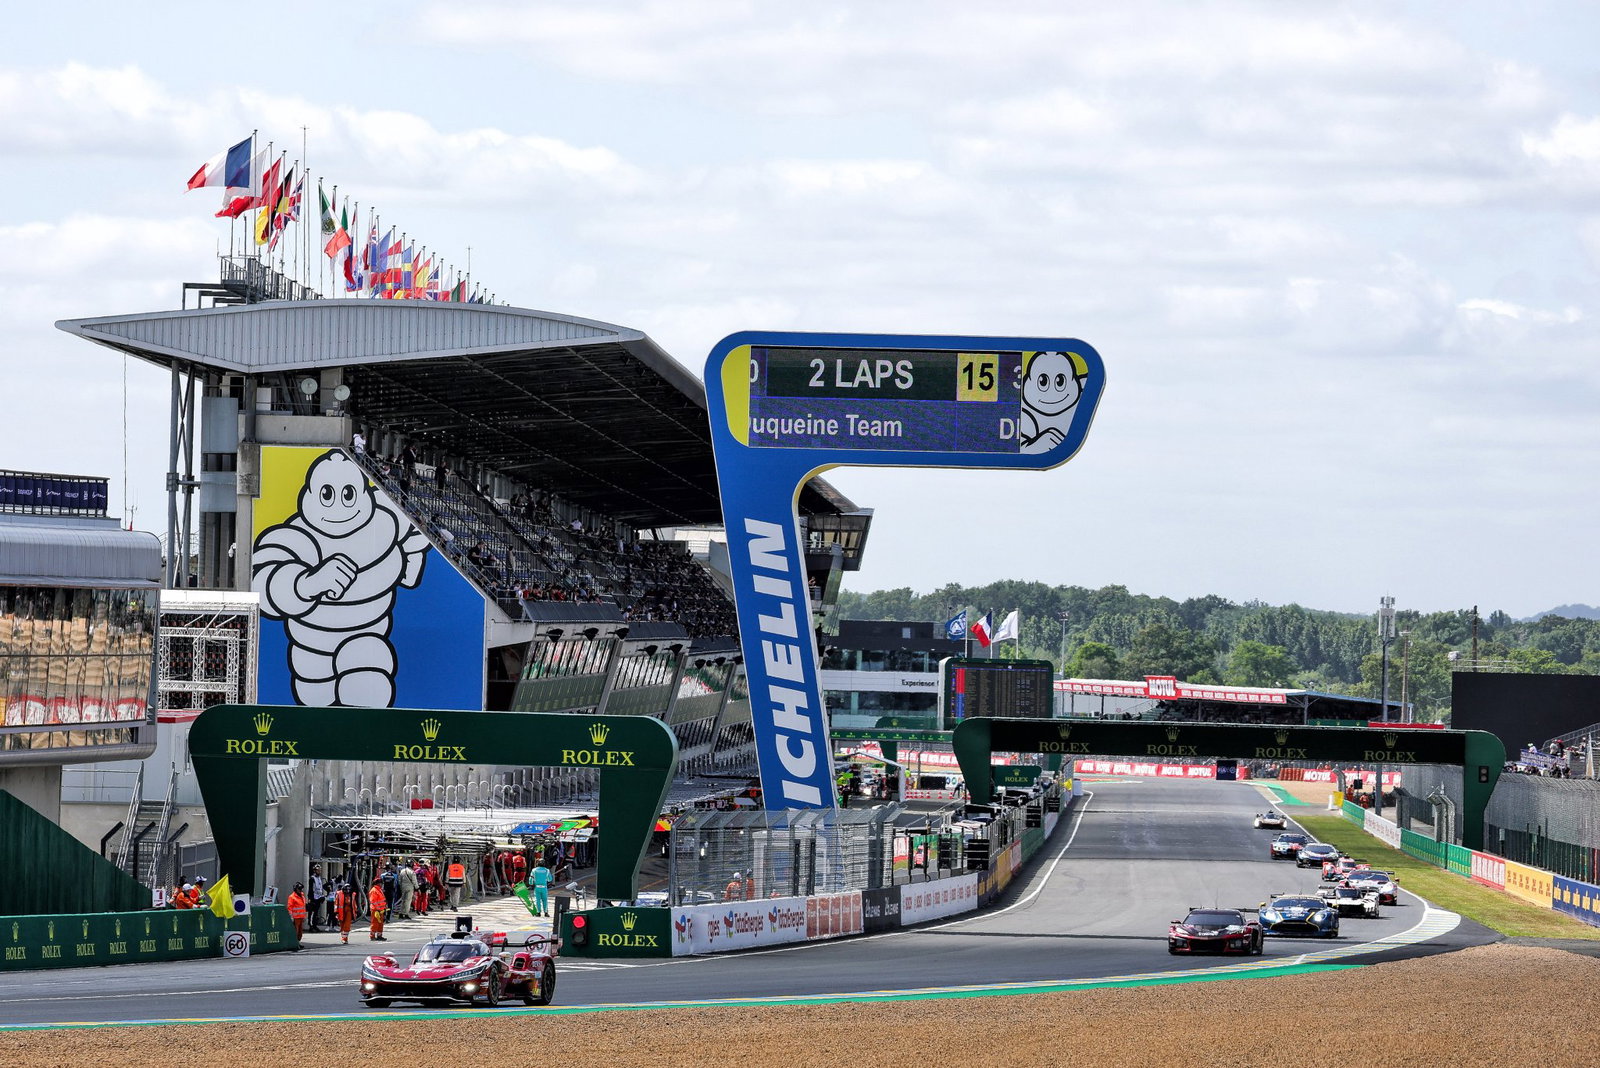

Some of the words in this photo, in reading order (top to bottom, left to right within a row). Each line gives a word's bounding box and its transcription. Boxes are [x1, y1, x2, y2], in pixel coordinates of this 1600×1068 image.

[808, 358, 825, 387] 2
[835, 359, 913, 390] LAPS
[963, 362, 994, 391] 15
[750, 413, 838, 440] uqueine
[845, 414, 902, 437] Team
[901, 679, 935, 687] Experience
[1149, 680, 1175, 695] MOTUL
[226, 739, 299, 755] ROLEX
[393, 745, 467, 760] ROLEX
[1039, 741, 1090, 753] ROLEX
[1147, 744, 1198, 756] ROLEX
[1255, 747, 1307, 759] ROLEX
[561, 750, 635, 766] ROLEX
[1364, 750, 1415, 762] ROLEX
[1161, 766, 1184, 776] MOTUL
[1188, 767, 1212, 777] MOTUL
[1303, 771, 1331, 781] MOTUL
[734, 910, 764, 937] TotalEnergies
[139, 940, 156, 952] ROLEX
[168, 938, 183, 950] ROLEX
[195, 936, 209, 948] ROLEX
[228, 939, 244, 950] 60
[597, 933, 658, 947] ROLEX
[5, 947, 26, 960] ROLEX
[42, 945, 61, 958] ROLEX
[76, 943, 95, 956] ROLEX
[109, 941, 127, 954] ROLEX
